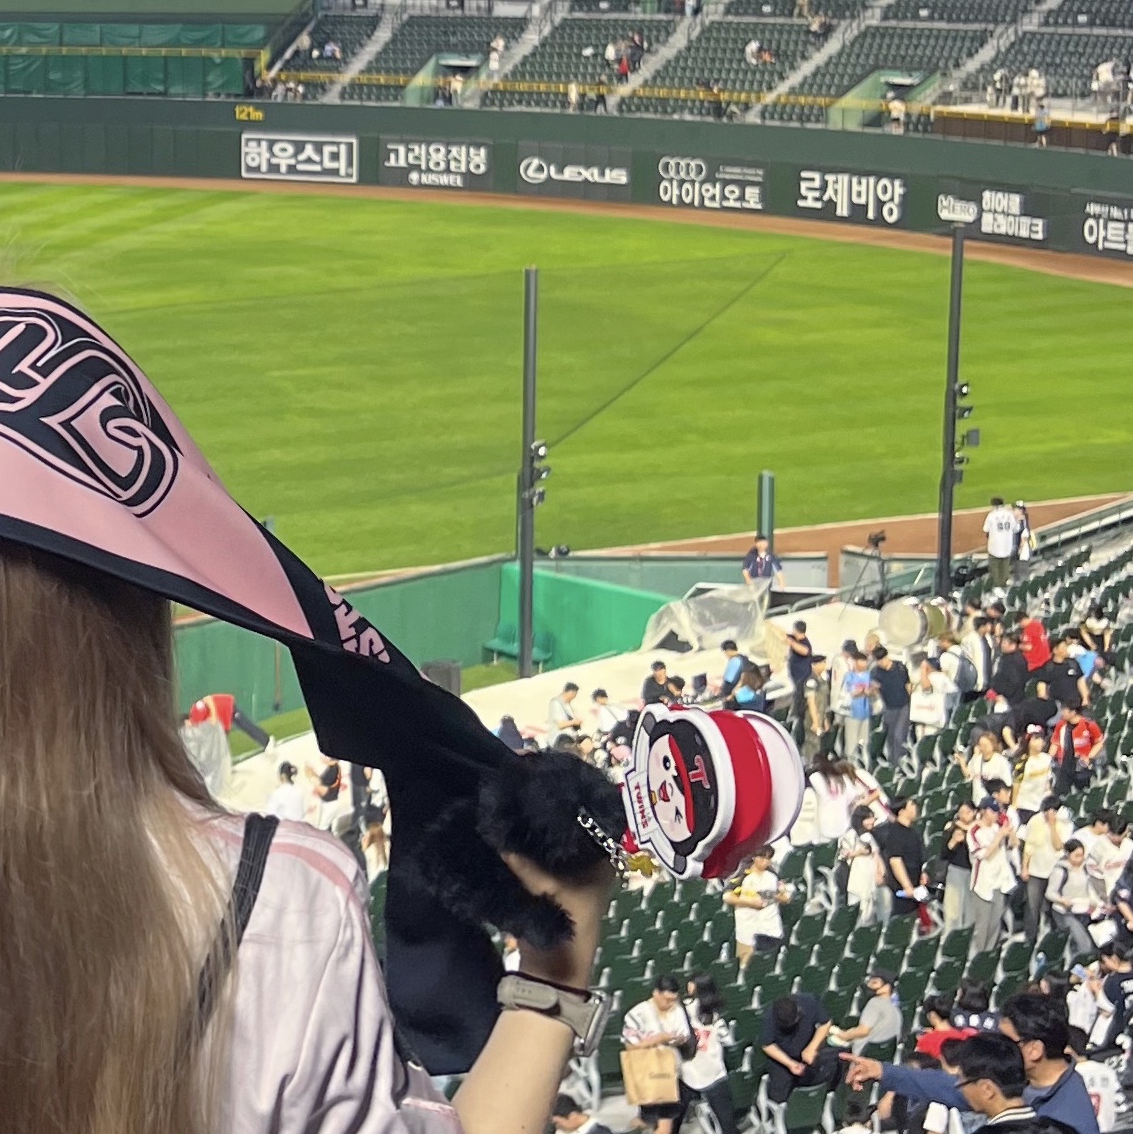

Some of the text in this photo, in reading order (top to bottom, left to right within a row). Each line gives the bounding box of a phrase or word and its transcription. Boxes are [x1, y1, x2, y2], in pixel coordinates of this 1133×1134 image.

[234, 105, 265, 122] 121m
[421, 172, 464, 188] KISWEL
[549, 164, 629, 185] LEXUS
[659, 180, 763, 209] 아이언오토
[797, 170, 905, 224] 로제비앙
[688, 754, 711, 789] T
[634, 781, 649, 829] TWINS
